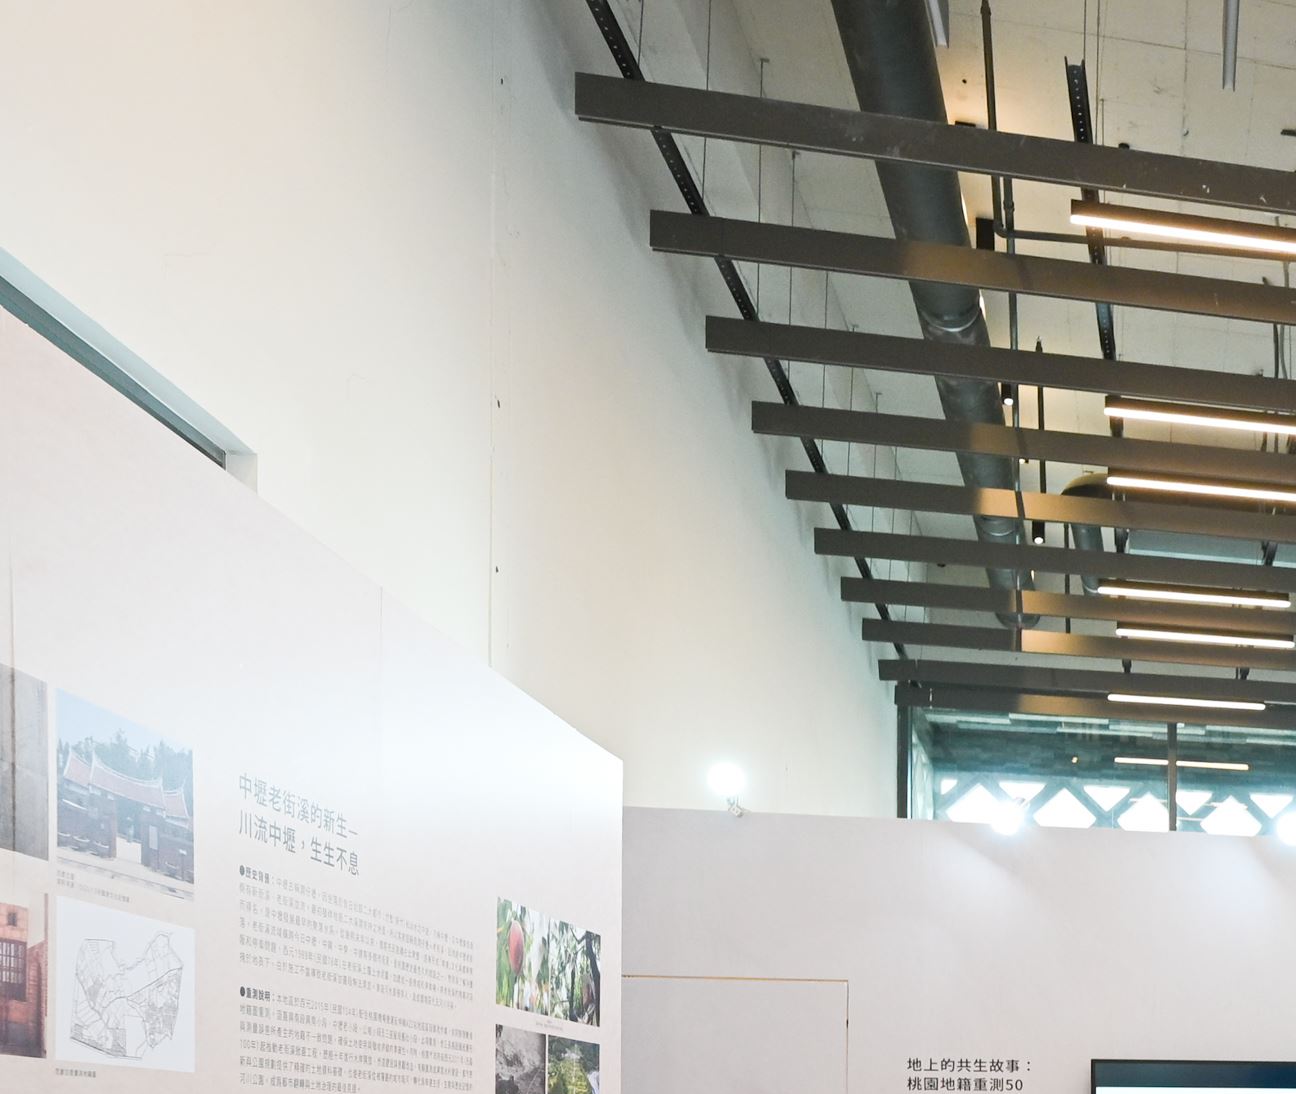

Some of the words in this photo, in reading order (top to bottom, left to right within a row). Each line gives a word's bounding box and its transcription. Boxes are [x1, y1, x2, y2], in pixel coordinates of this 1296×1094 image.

[238, 809, 359, 876] 川流中壢，生生不息
[907, 1058, 1031, 1073] 地上的共生故事：
[907, 1077, 1024, 1092] 桃園地籍重測50
